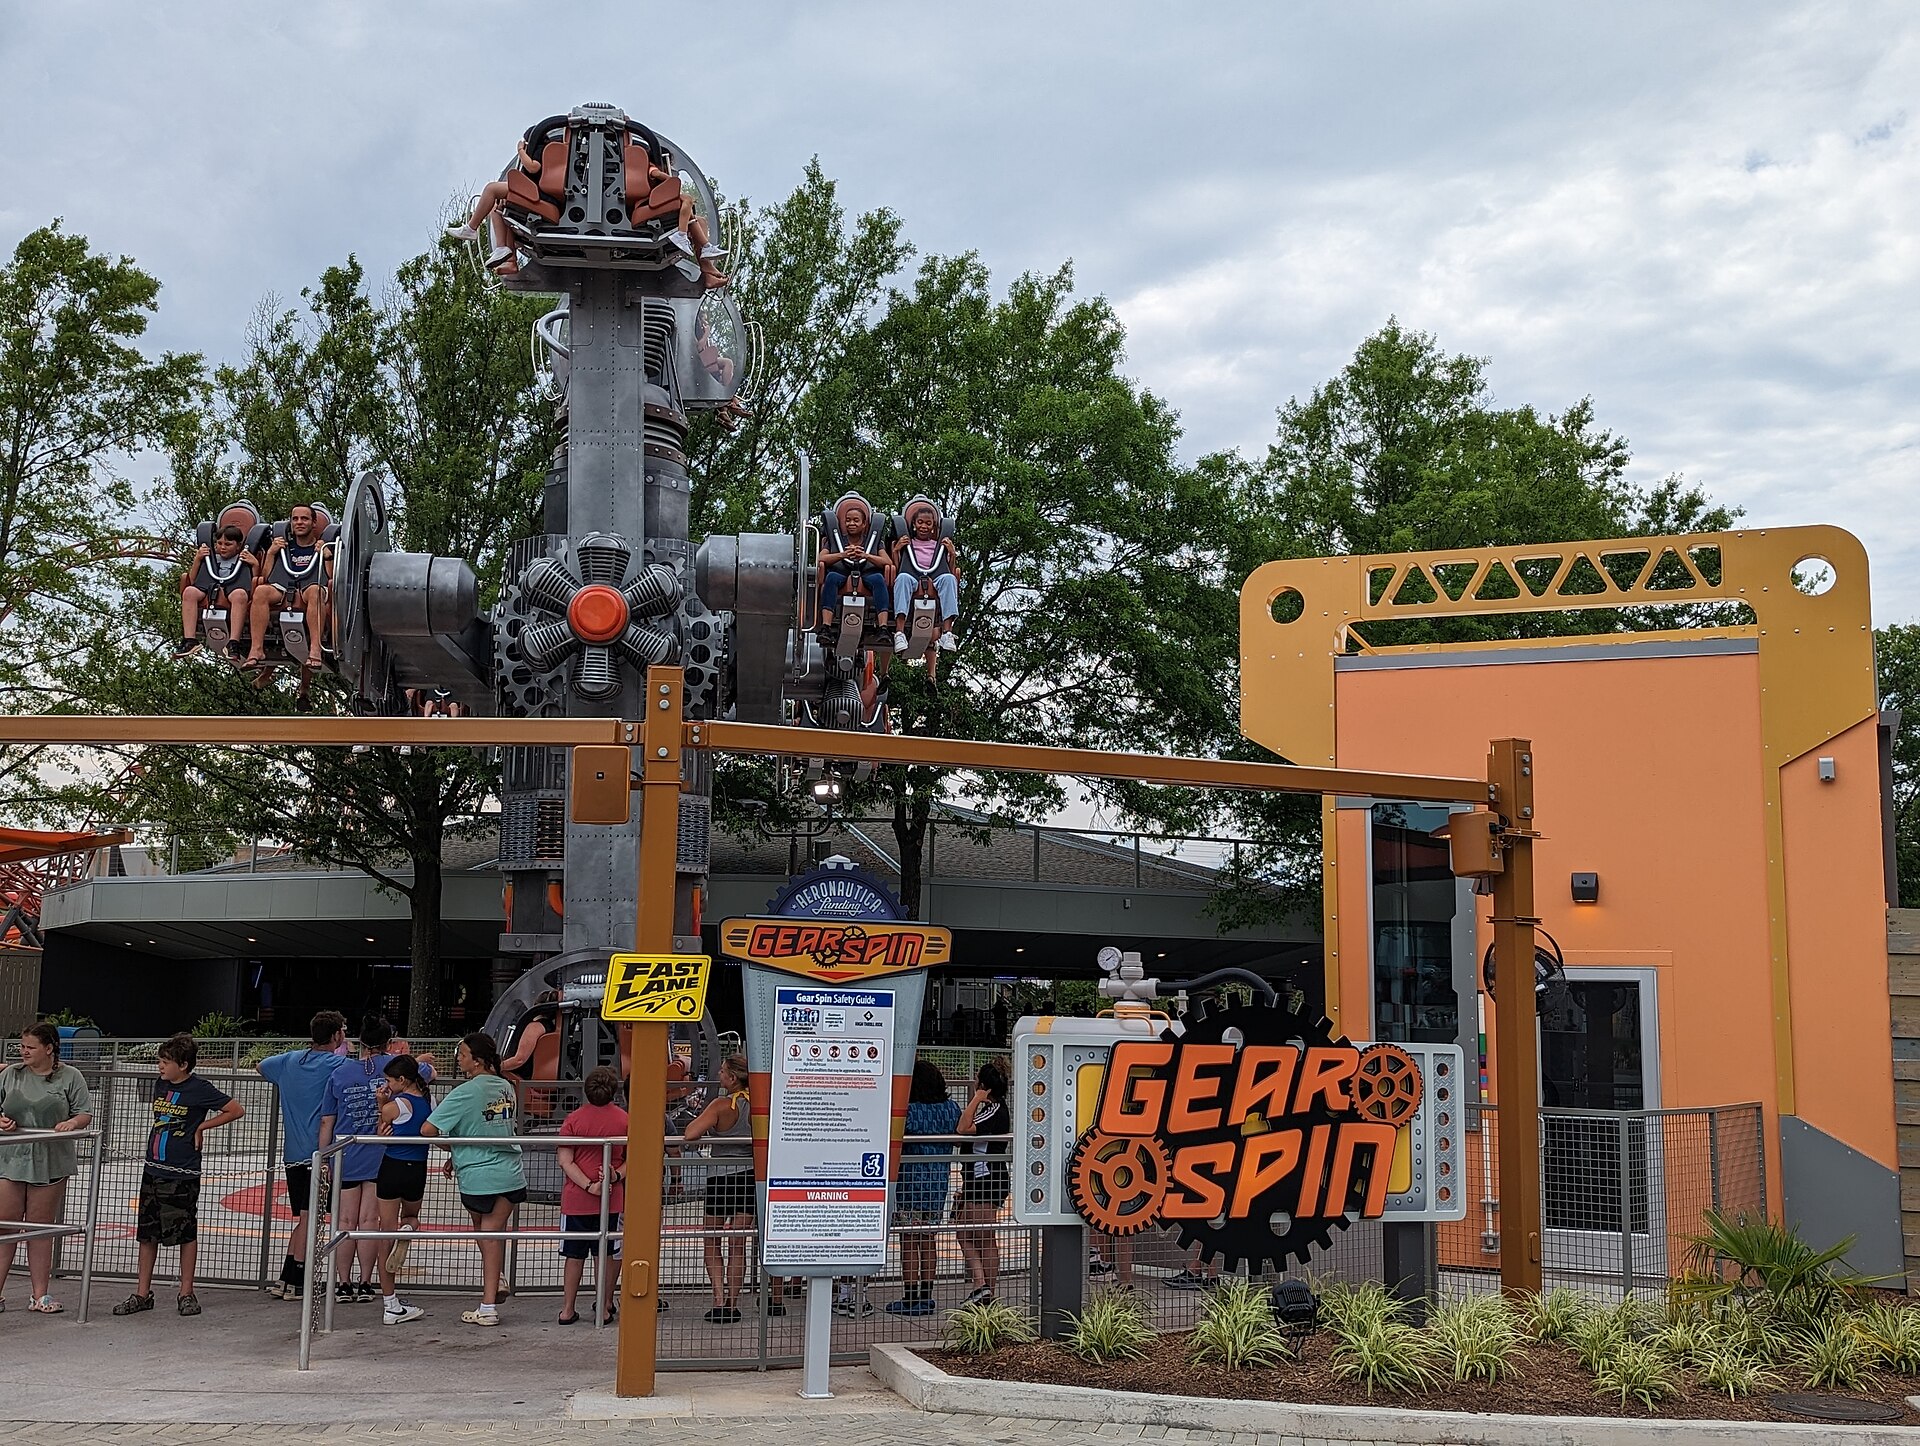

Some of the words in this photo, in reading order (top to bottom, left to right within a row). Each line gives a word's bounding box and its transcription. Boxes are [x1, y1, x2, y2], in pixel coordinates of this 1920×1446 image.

[795, 881, 882, 912] AERONAUTICA
[811, 897, 866, 917] Landing
[750, 926, 843, 957] GEAR
[840, 932, 924, 966] SPIN
[617, 962, 703, 981] FAST
[613, 977, 700, 1003] LANE
[796, 993, 814, 1003] Gear
[814, 994, 832, 1005] Spin
[832, 994, 854, 1006] Safety
[855, 994, 876, 1005] Guide
[1099, 1042, 1359, 1135] GEAR
[154, 1106, 188, 1116] FURIOUS
[1161, 1123, 1397, 1219] SPIN
[806, 1192, 848, 1200] WARNING
